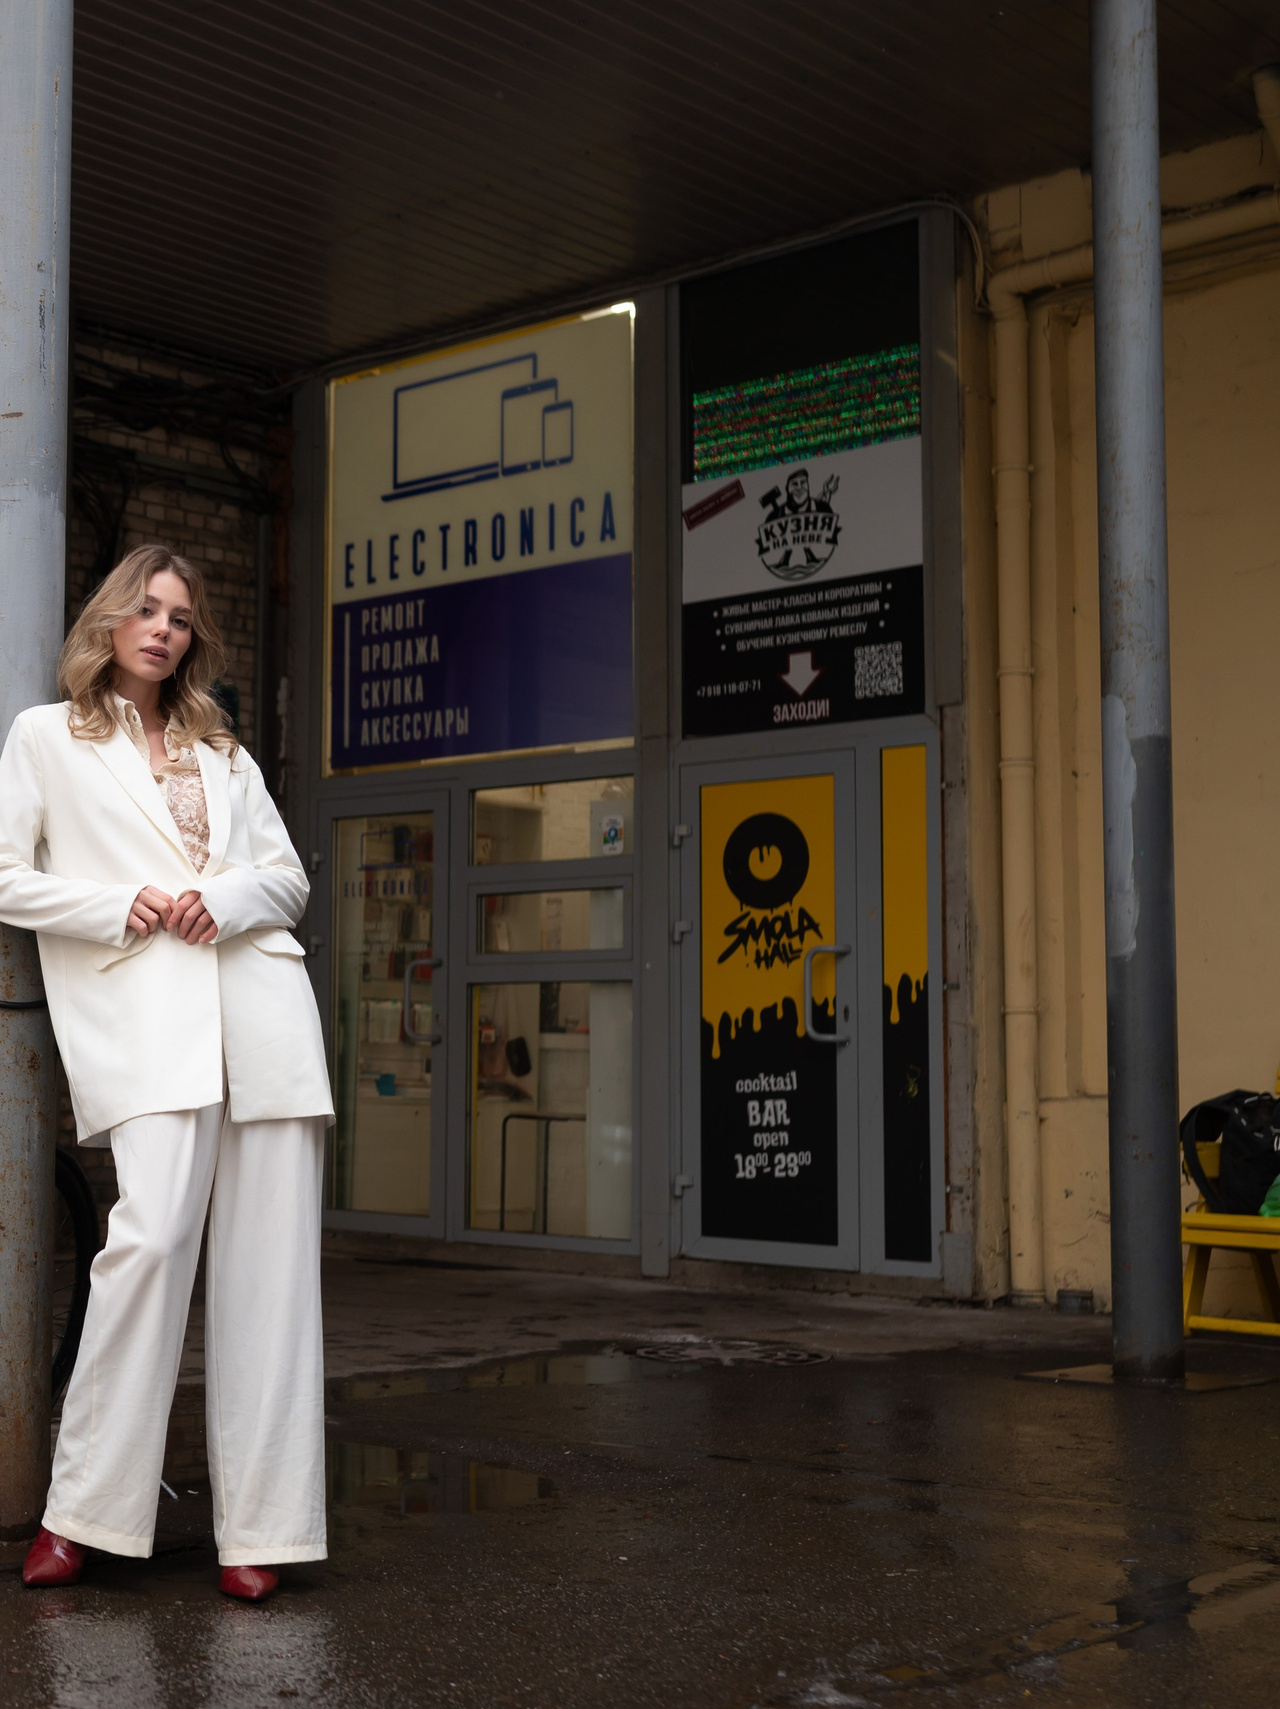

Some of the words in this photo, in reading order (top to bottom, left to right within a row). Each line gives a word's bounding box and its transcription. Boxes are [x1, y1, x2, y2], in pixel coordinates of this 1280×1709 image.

[345, 492, 616, 588] ELECTRONICA
[763, 514, 835, 541] КУЗНЯ
[772, 538, 789, 550] НА
[361, 599, 425, 636] РЕМОНТ
[775, 612, 801, 628] ЛАВКА
[829, 621, 868, 638] РЕМЕСЛУ
[361, 634, 440, 673] ПРОДАЖА
[361, 674, 424, 710] СКУПКА
[773, 699, 830, 724] ЗАХОДИ!
[361, 706, 469, 747] АКСЕССУАРЫ
[718, 906, 823, 964] SMOLA
[754, 943, 803, 970] HALL
[735, 1070, 798, 1094] cocktail
[747, 1098, 791, 1127] BAR
[753, 1130, 789, 1150] open
